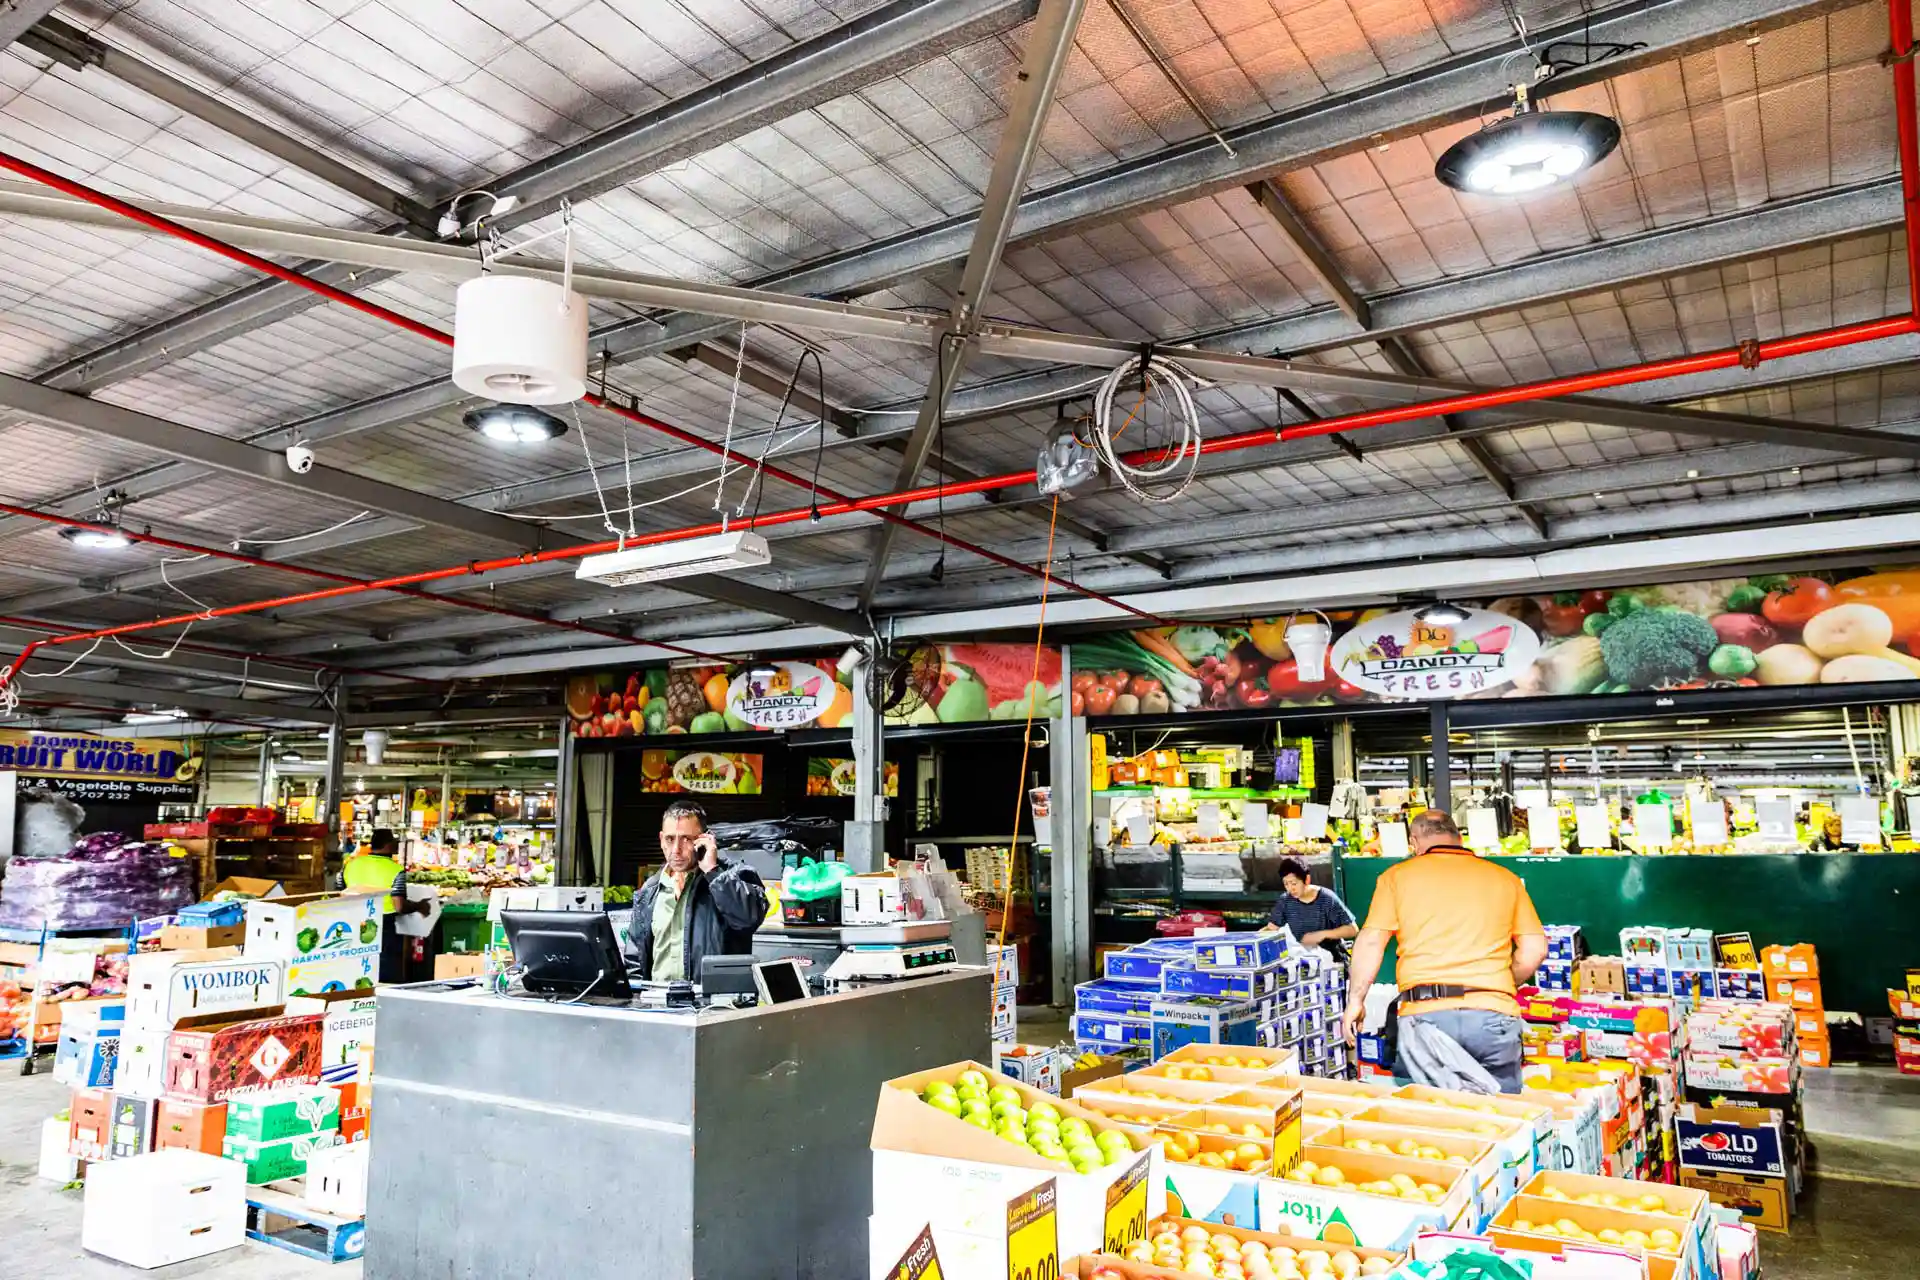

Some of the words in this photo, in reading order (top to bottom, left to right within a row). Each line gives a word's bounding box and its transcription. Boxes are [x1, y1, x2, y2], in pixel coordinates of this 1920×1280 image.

[1380, 655, 1477, 670] DANDY
[1382, 671, 1485, 692] FRESH
[752, 696, 803, 707] DANDY
[753, 706, 807, 723] FRESH
[32, 735, 136, 751] DOMENICS
[74, 749, 177, 778] WORLD
[36, 779, 48, 788] &
[55, 779, 132, 792] Vegetable
[136, 783, 193, 794] Supplies
[79, 791, 105, 799] 707
[108, 792, 131, 800] 232
[339, 944, 380, 957] PRODUCE
[183, 968, 271, 991] WOMBOK
[1164, 1009, 1204, 1021] Winpack
[329, 1016, 374, 1032] ICEBERG
[1562, 1145, 1575, 1169] D
[1706, 1151, 1755, 1164] TOMATOES
[1036, 1184, 1056, 1207] Fresh
[906, 1236, 931, 1273] Fresh
